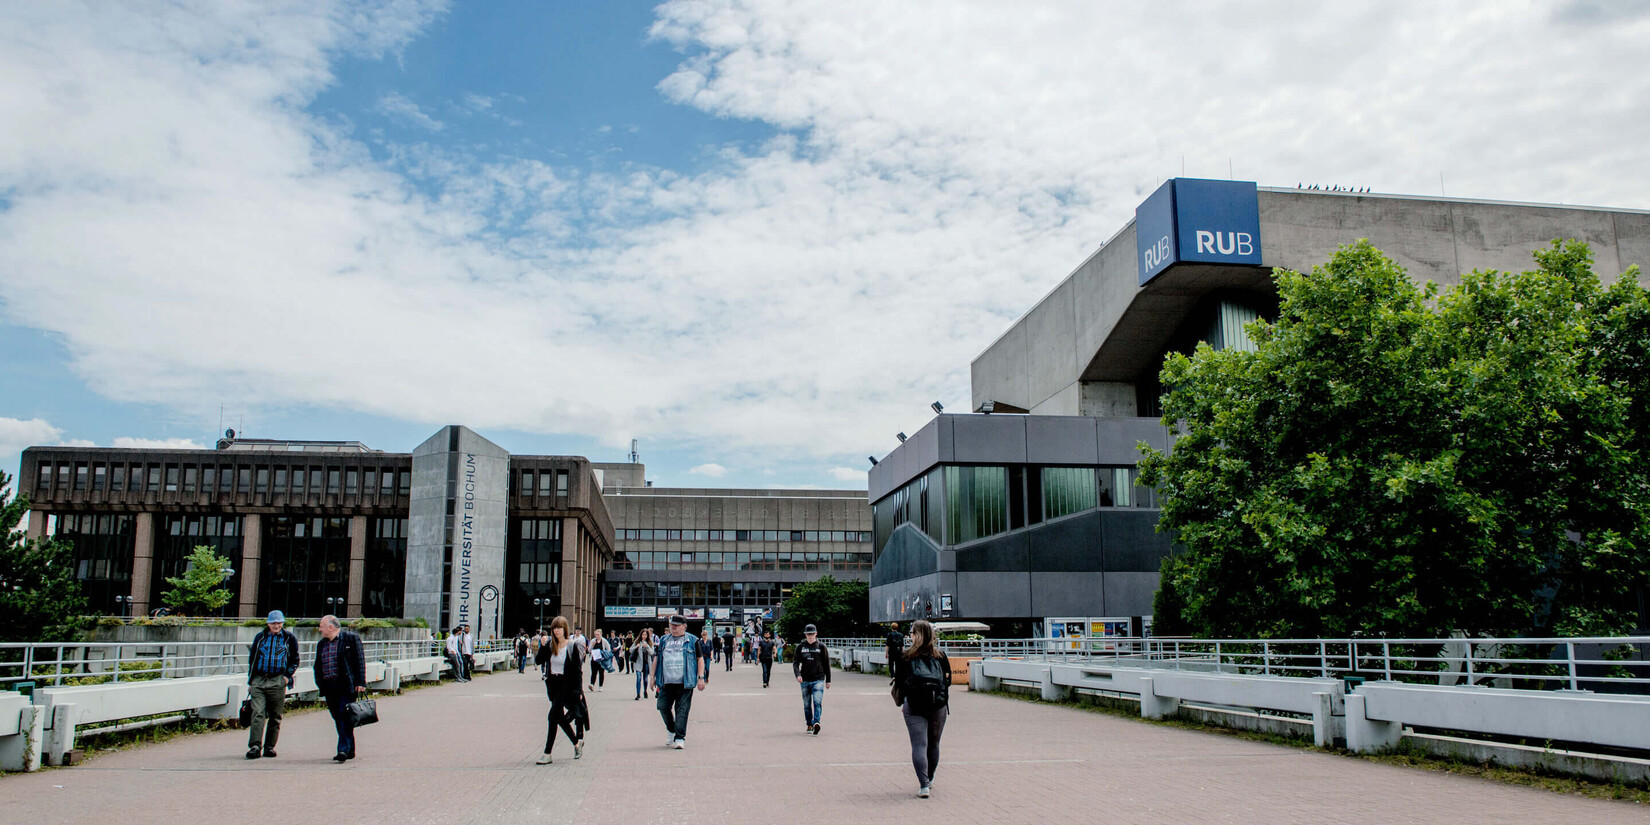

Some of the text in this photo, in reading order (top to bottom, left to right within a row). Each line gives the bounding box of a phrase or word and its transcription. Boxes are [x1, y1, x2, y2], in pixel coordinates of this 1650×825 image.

[1144, 235, 1170, 273] RUB
[1195, 230, 1254, 256] RUB
[464, 454, 476, 510] BOCHUM
